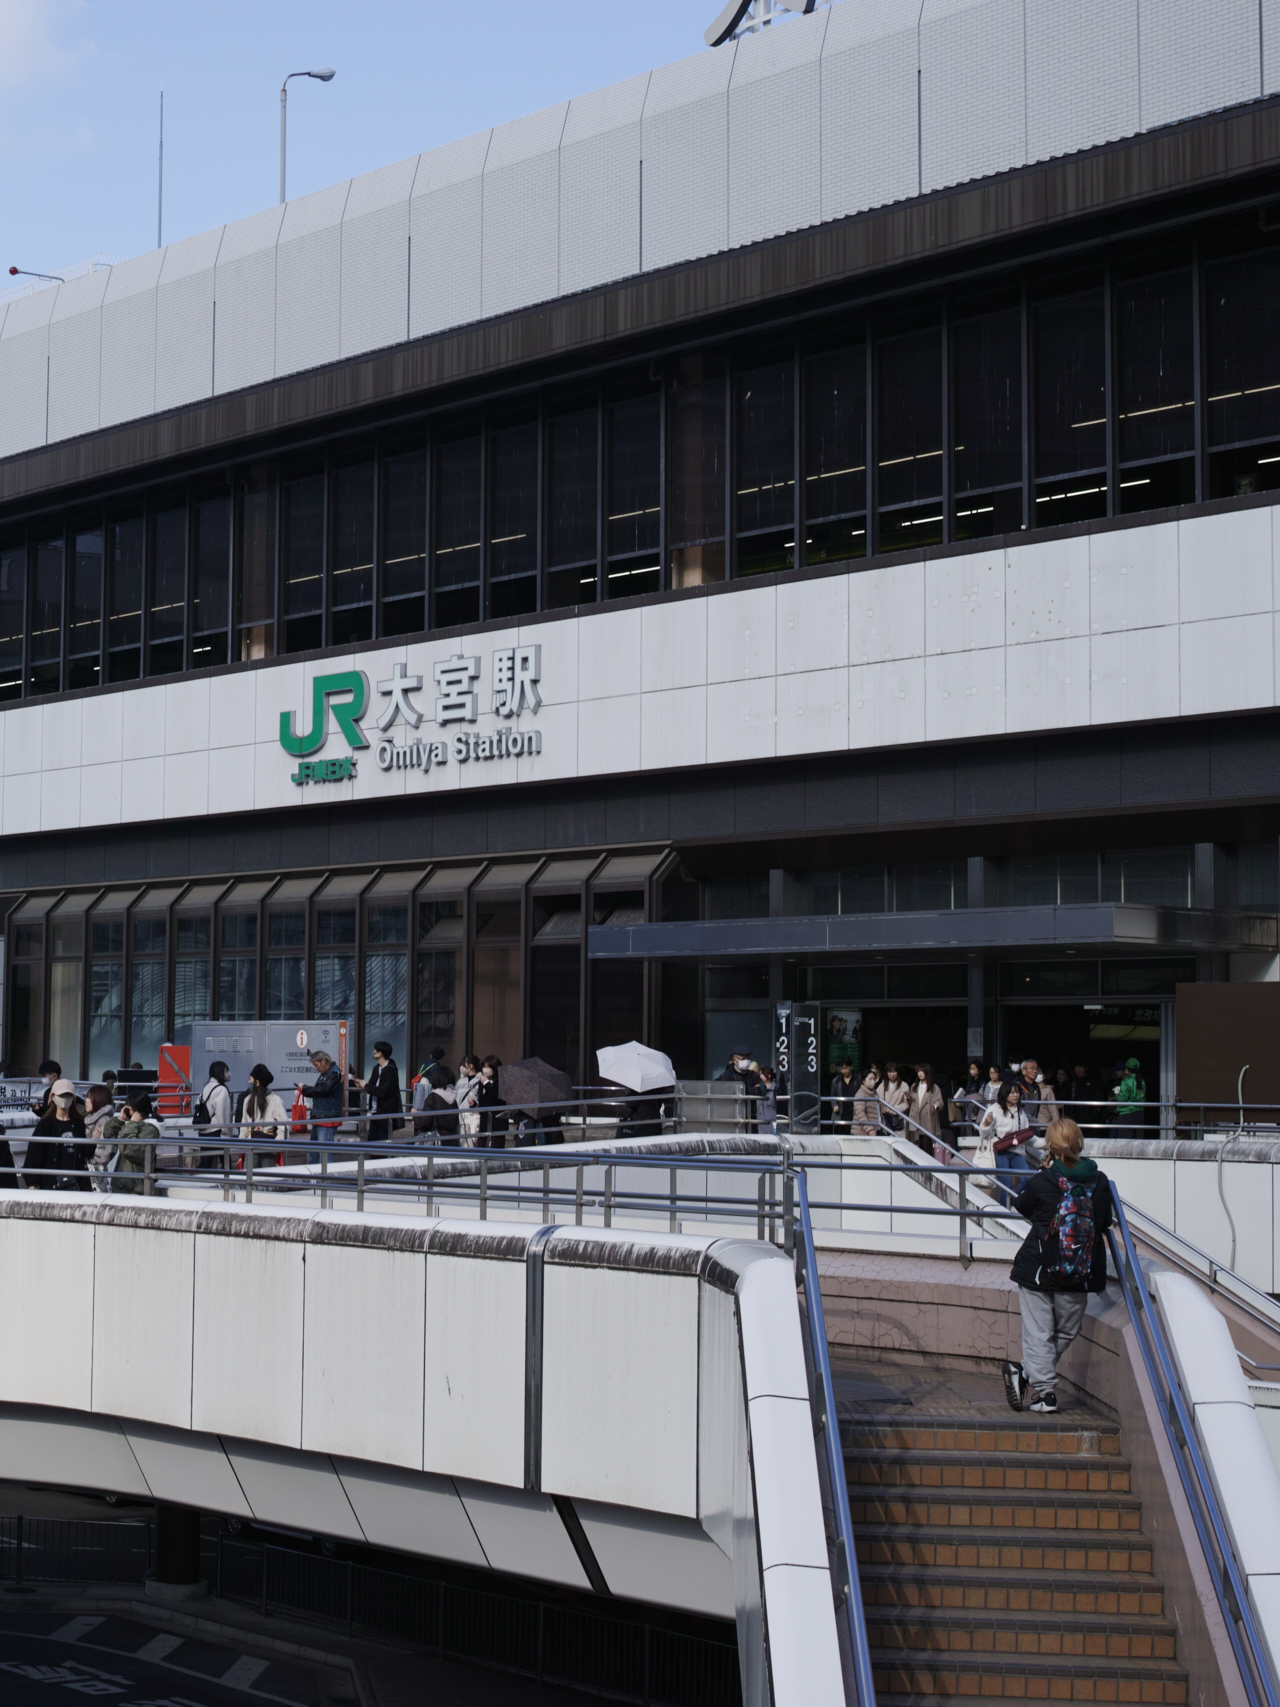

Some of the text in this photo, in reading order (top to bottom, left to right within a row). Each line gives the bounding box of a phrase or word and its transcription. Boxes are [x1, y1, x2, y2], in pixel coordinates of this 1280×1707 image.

[376, 644, 542, 732] 大宮駅
[280, 670, 370, 756] JR
[375, 726, 542, 773] Ōmiya Station
[290, 756, 358, 786] JR東日本
[780, 1017, 786, 1034] 1
[808, 1017, 814, 1034] 1
[779, 1036, 788, 1053] 2
[807, 1036, 817, 1053] 2
[778, 1055, 788, 1072] 3
[807, 1055, 817, 1072] 3
